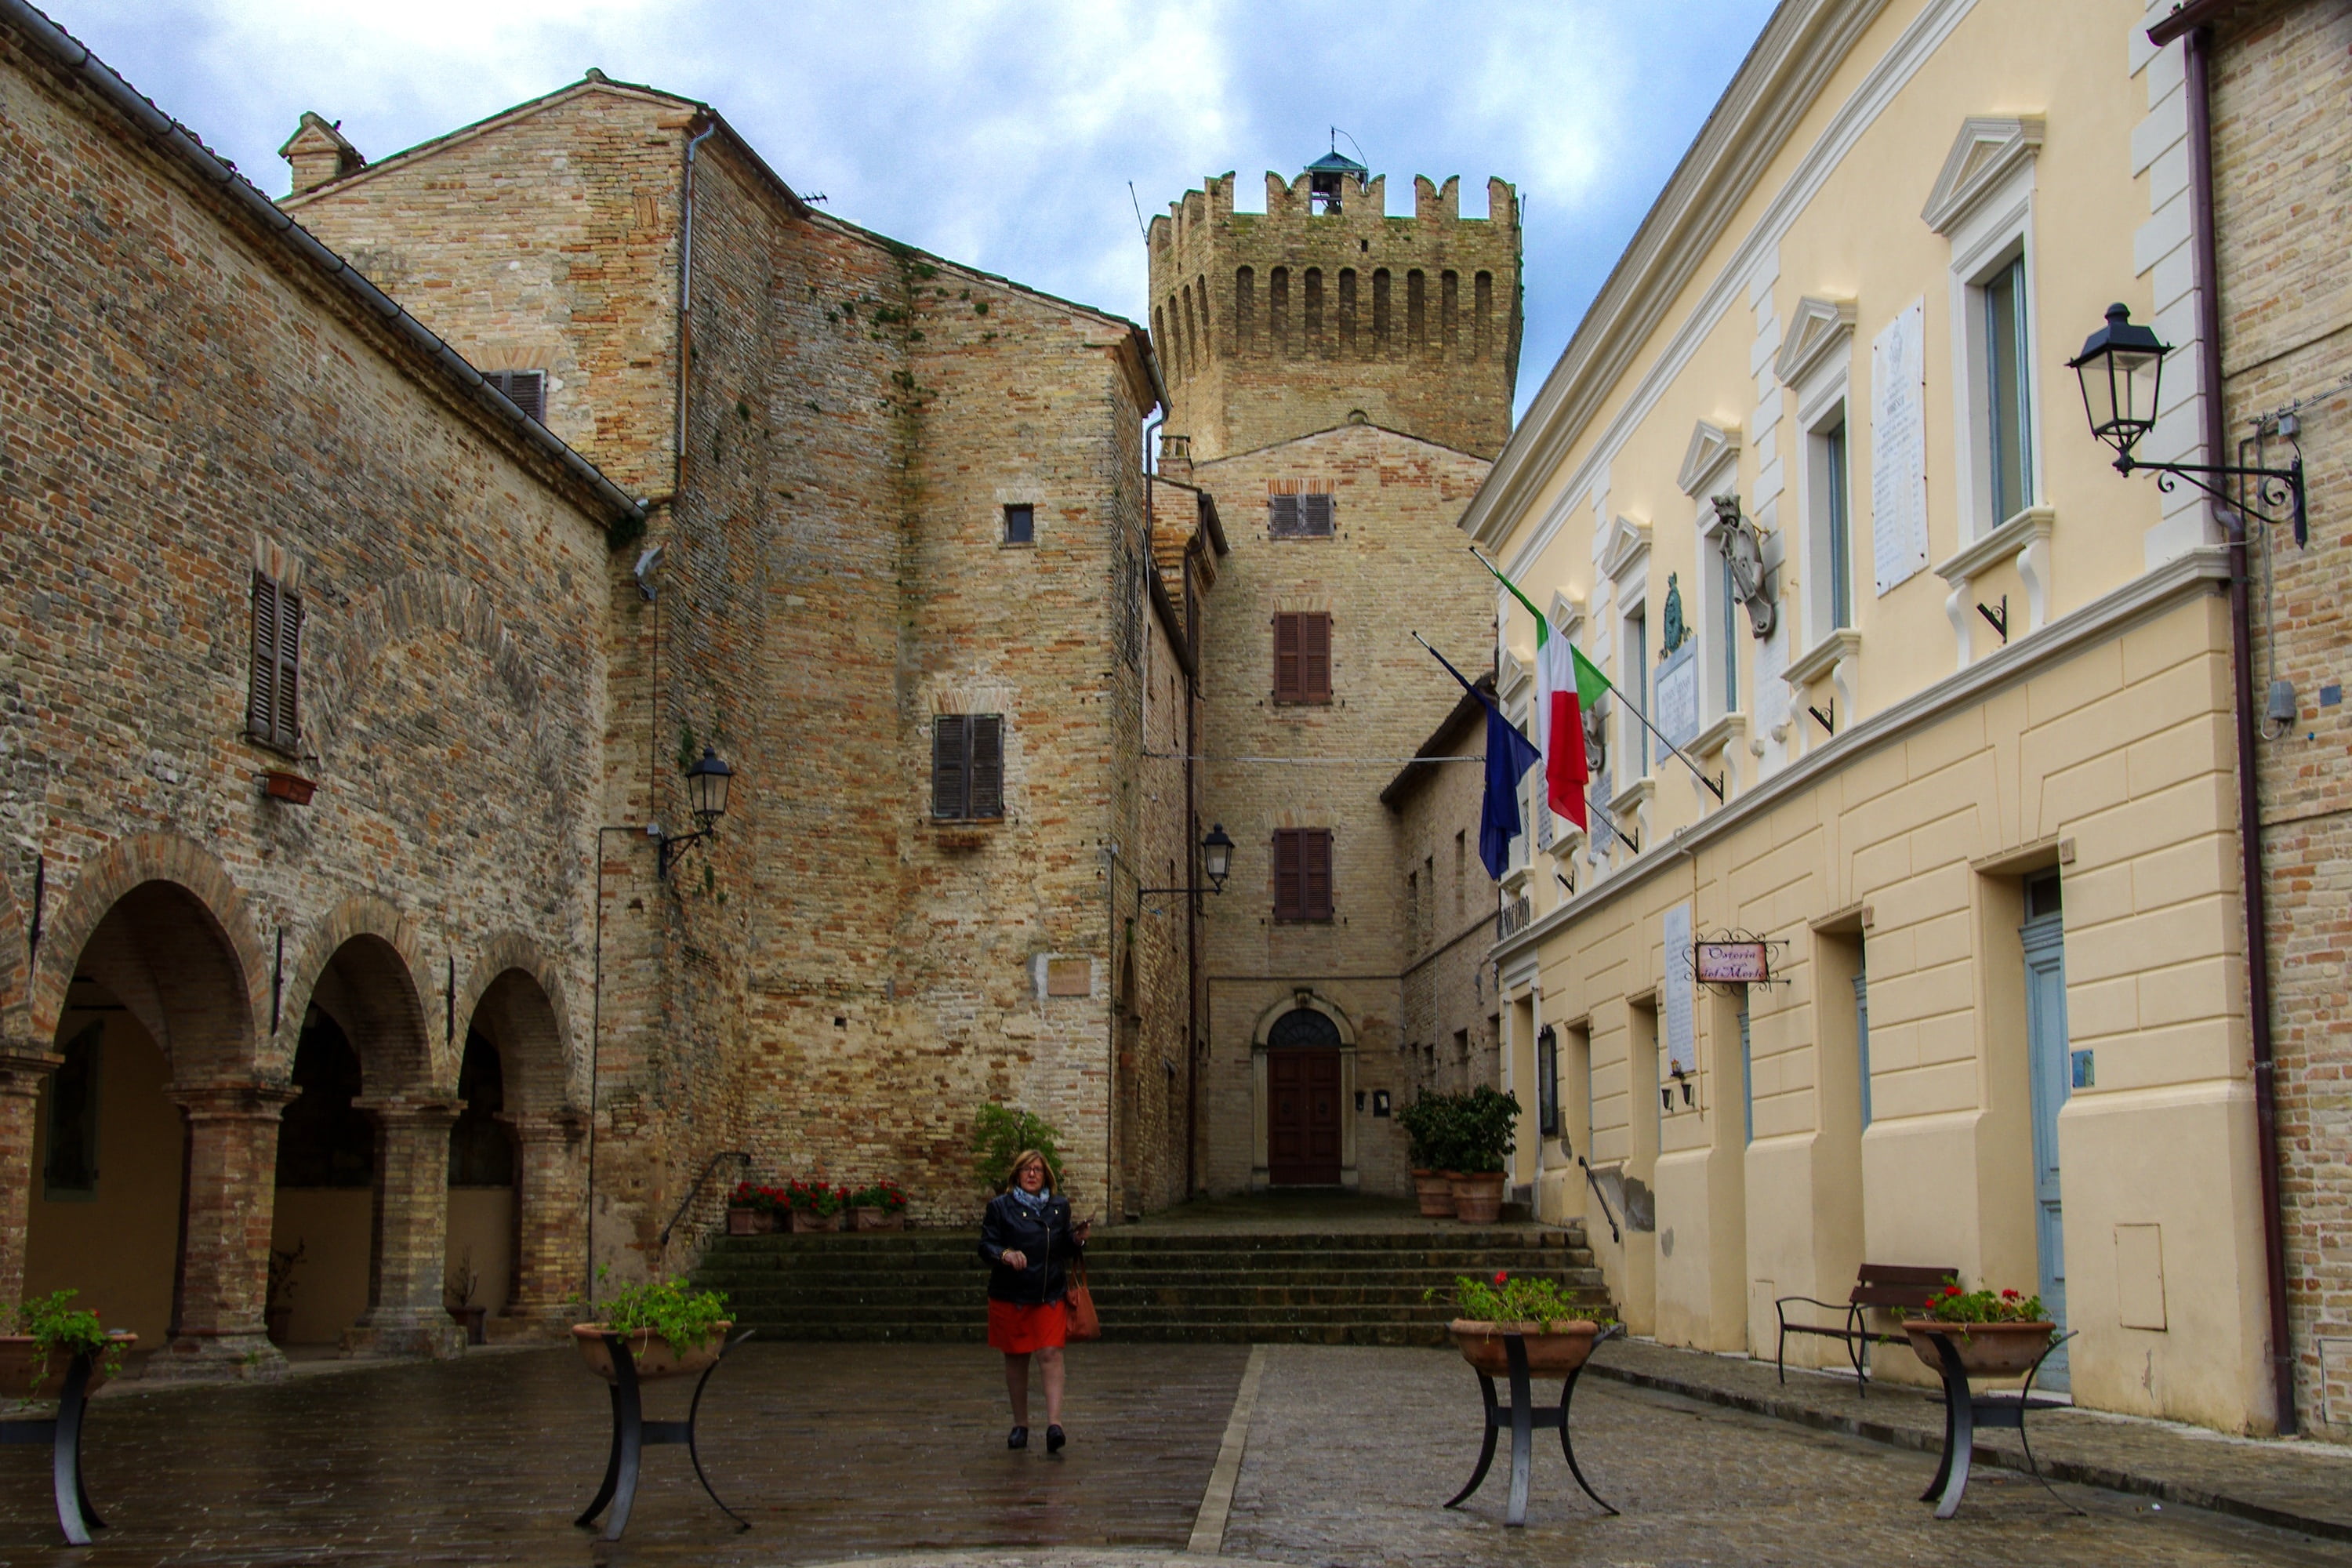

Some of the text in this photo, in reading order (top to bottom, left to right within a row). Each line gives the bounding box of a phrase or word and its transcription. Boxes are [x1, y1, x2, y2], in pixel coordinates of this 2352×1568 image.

[1497, 895, 1530, 942] NICIPIO
[1708, 947, 1755, 960] Osteria
[1700, 967, 1719, 978] del
